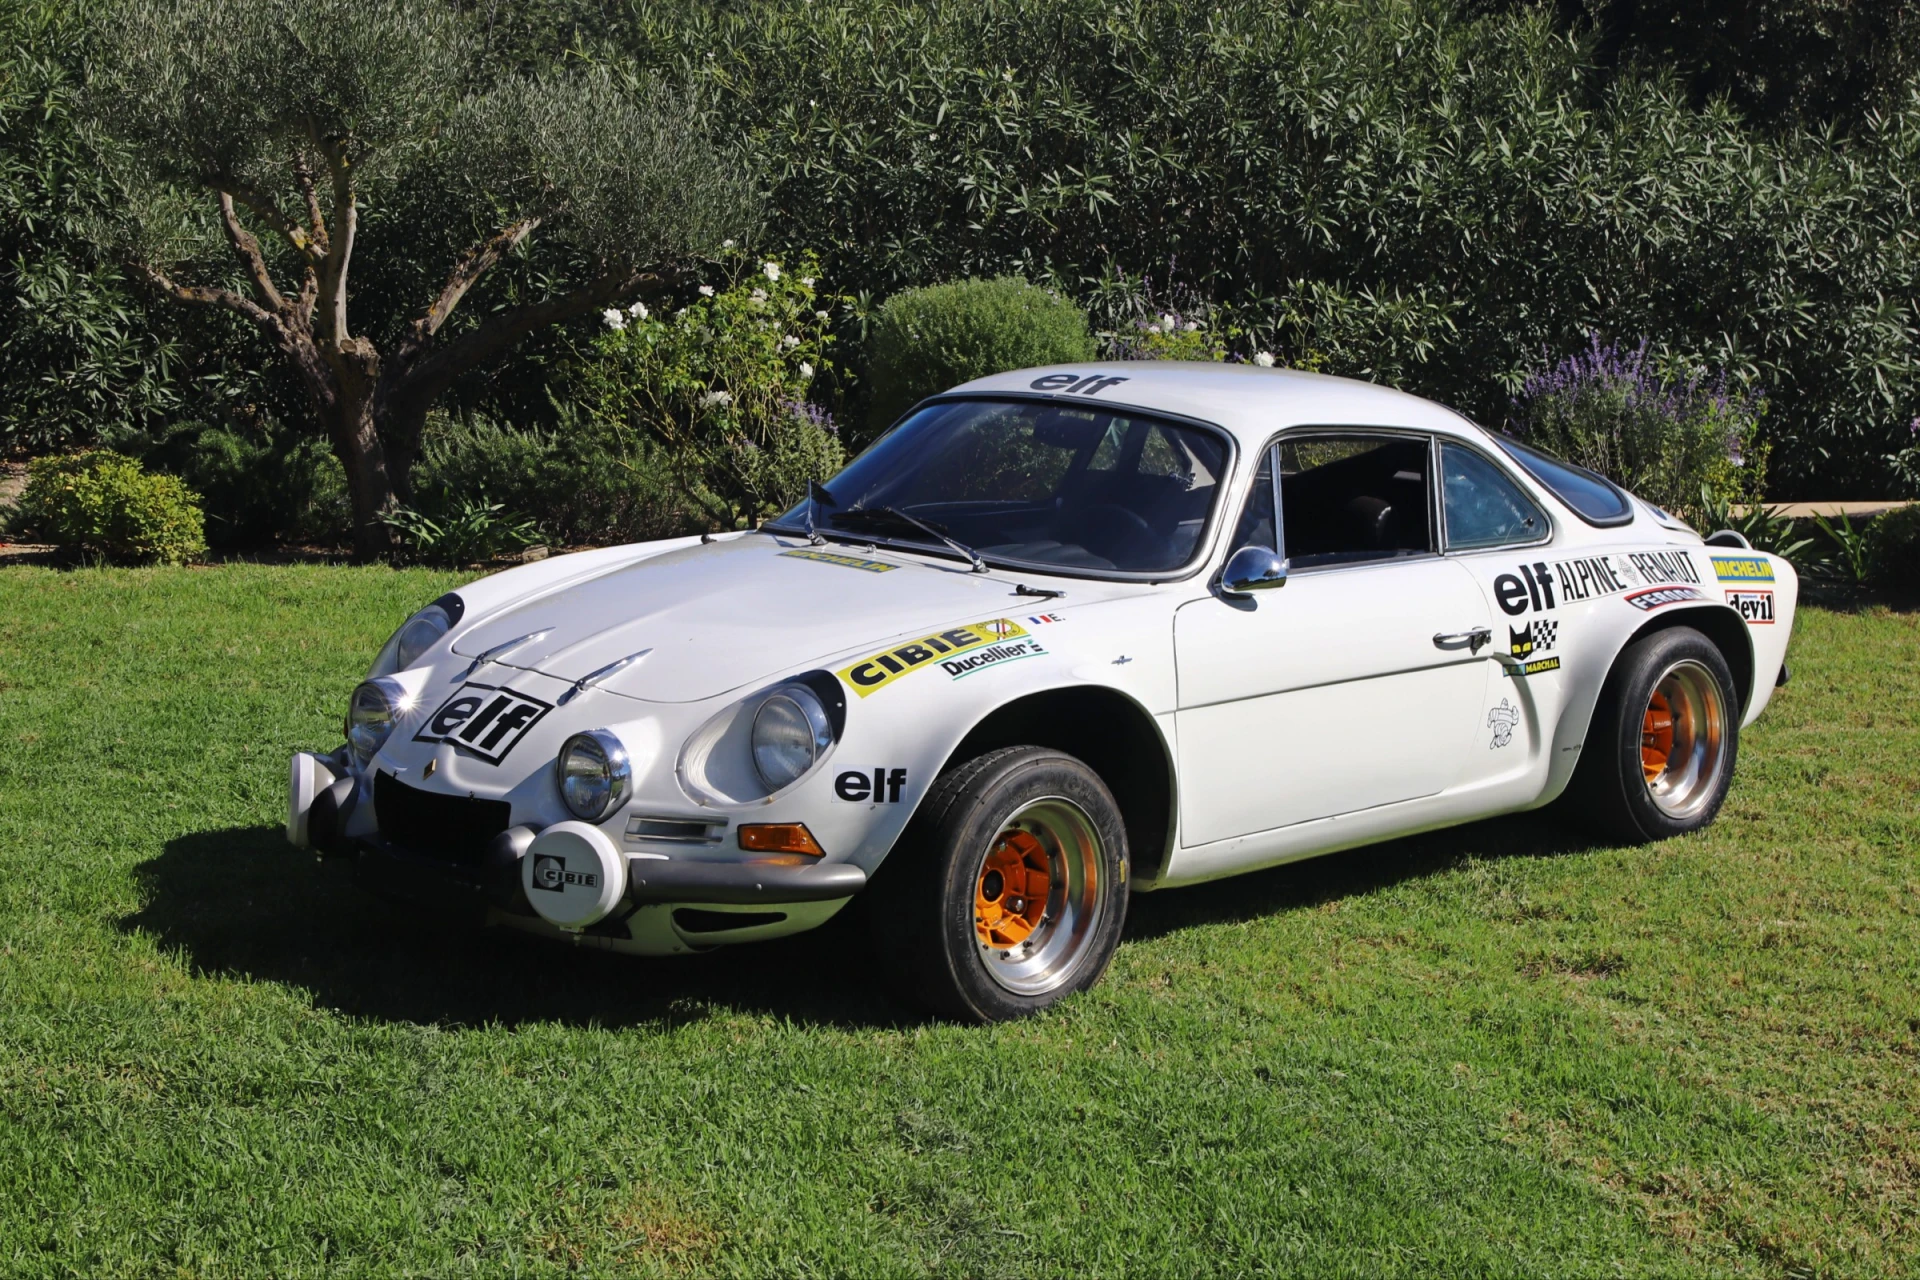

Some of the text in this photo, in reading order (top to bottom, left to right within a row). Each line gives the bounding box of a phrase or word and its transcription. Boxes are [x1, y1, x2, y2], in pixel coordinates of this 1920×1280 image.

[1030, 374, 1130, 395] elf
[1555, 551, 1701, 601] ALPINE RENAULT
[1712, 561, 1774, 577] MICHELIN
[1494, 562, 1555, 616] elf
[1729, 594, 1773, 620] devil
[940, 643, 1027, 676] Ducellier
[1525, 658, 1559, 674] MARCHAL
[431, 694, 540, 751] elf
[834, 768, 907, 803] elf
